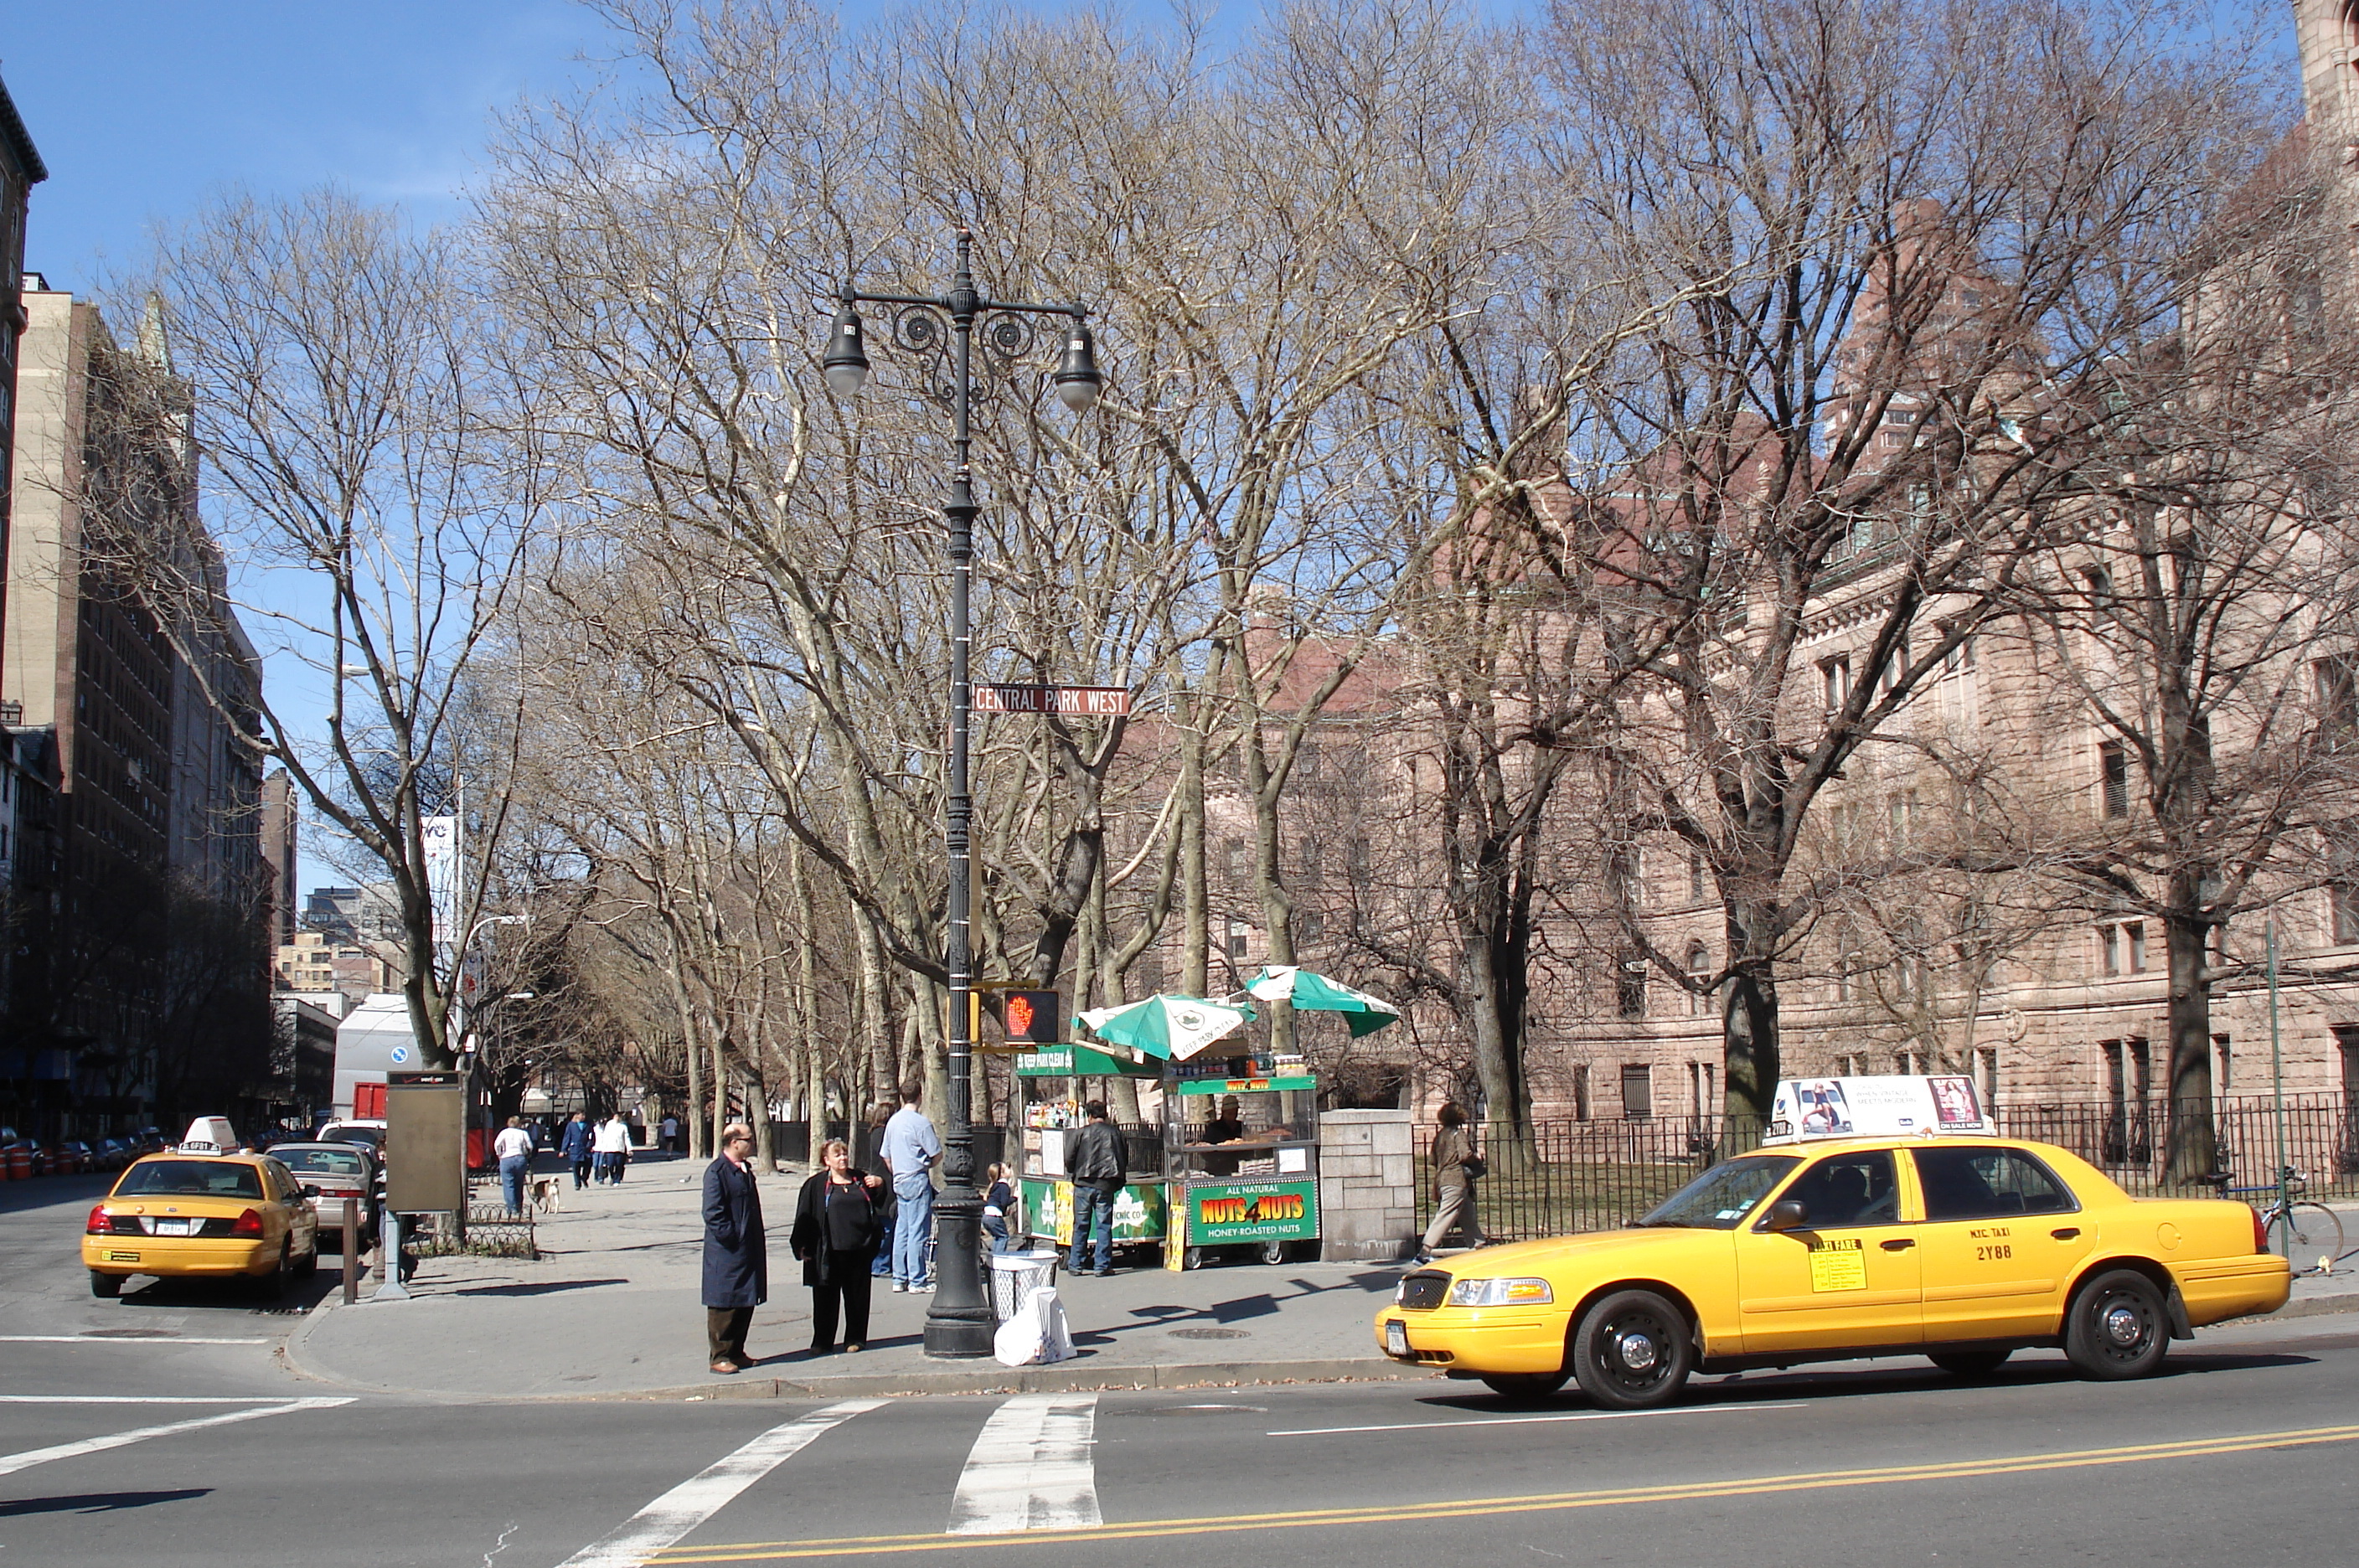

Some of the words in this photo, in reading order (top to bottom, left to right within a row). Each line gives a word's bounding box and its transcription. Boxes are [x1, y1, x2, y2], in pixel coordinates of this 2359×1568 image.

[976, 687, 1039, 710] CENTRAL
[1045, 689, 1081, 712] PARK
[1087, 691, 1124, 713] WEST
[1181, 1039, 1198, 1055] KEEP
[1198, 1029, 1214, 1045] PARK
[1024, 1054, 1036, 1068] KEEP
[1036, 1053, 1049, 1067] PARK
[1049, 1052, 1065, 1067] CLEAN
[1242, 1184, 1279, 1194] NATURAL
[1112, 1210, 1131, 1220] ICNIC
[1132, 1211, 1141, 1220] CO
[1278, 1224, 1300, 1233] NUTS
[1990, 1227, 2011, 1237] TAXI
[1834, 1240, 1858, 1251] FARE
[1976, 1245, 2012, 1261] 2Y88
